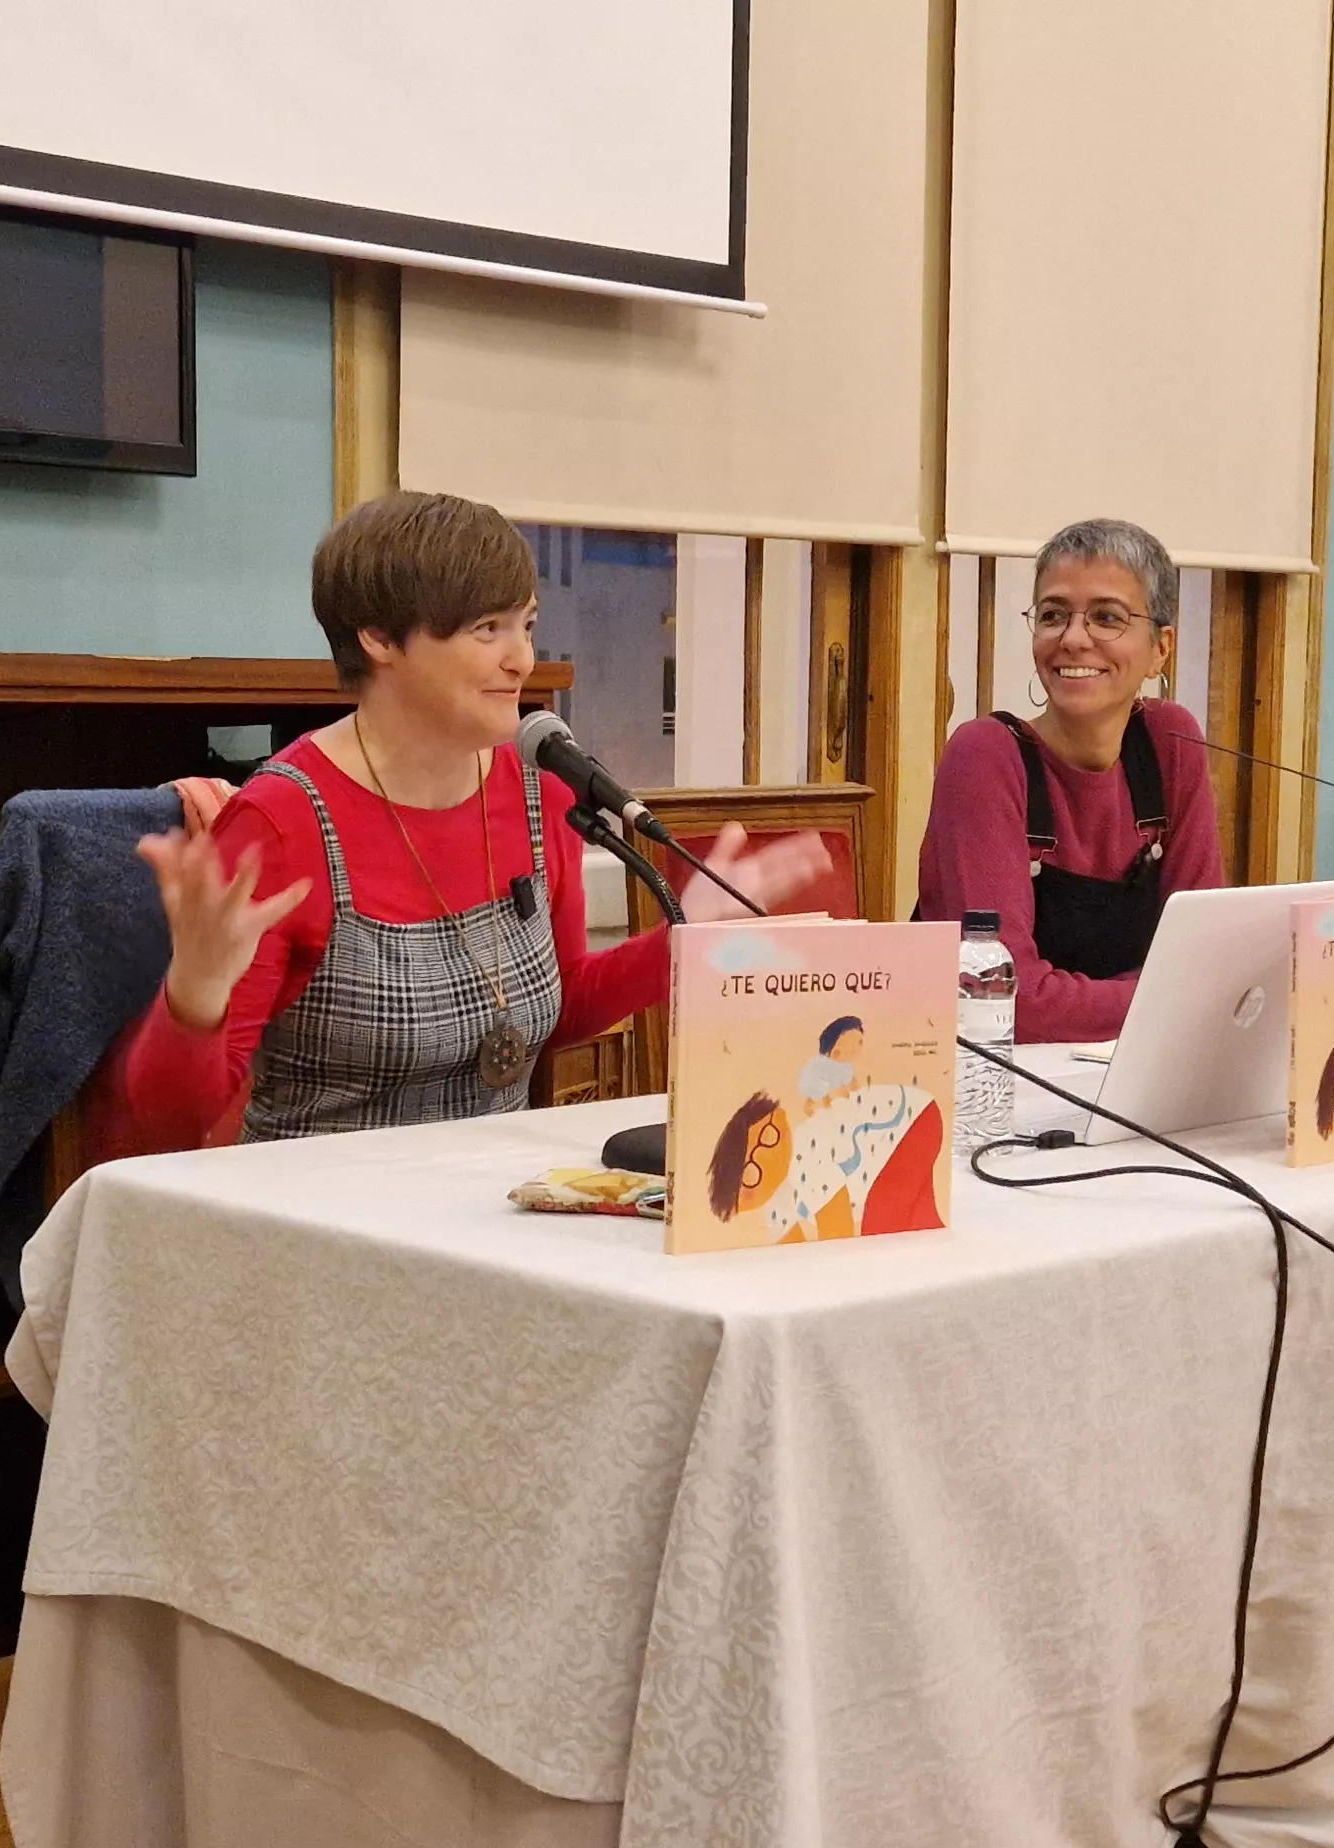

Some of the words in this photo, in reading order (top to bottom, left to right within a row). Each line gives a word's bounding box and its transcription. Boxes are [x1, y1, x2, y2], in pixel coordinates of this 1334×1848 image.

[721, 975, 755, 997] ¿TE
[765, 973, 836, 996] QUIERO
[845, 966, 892, 993] QUÉ?
